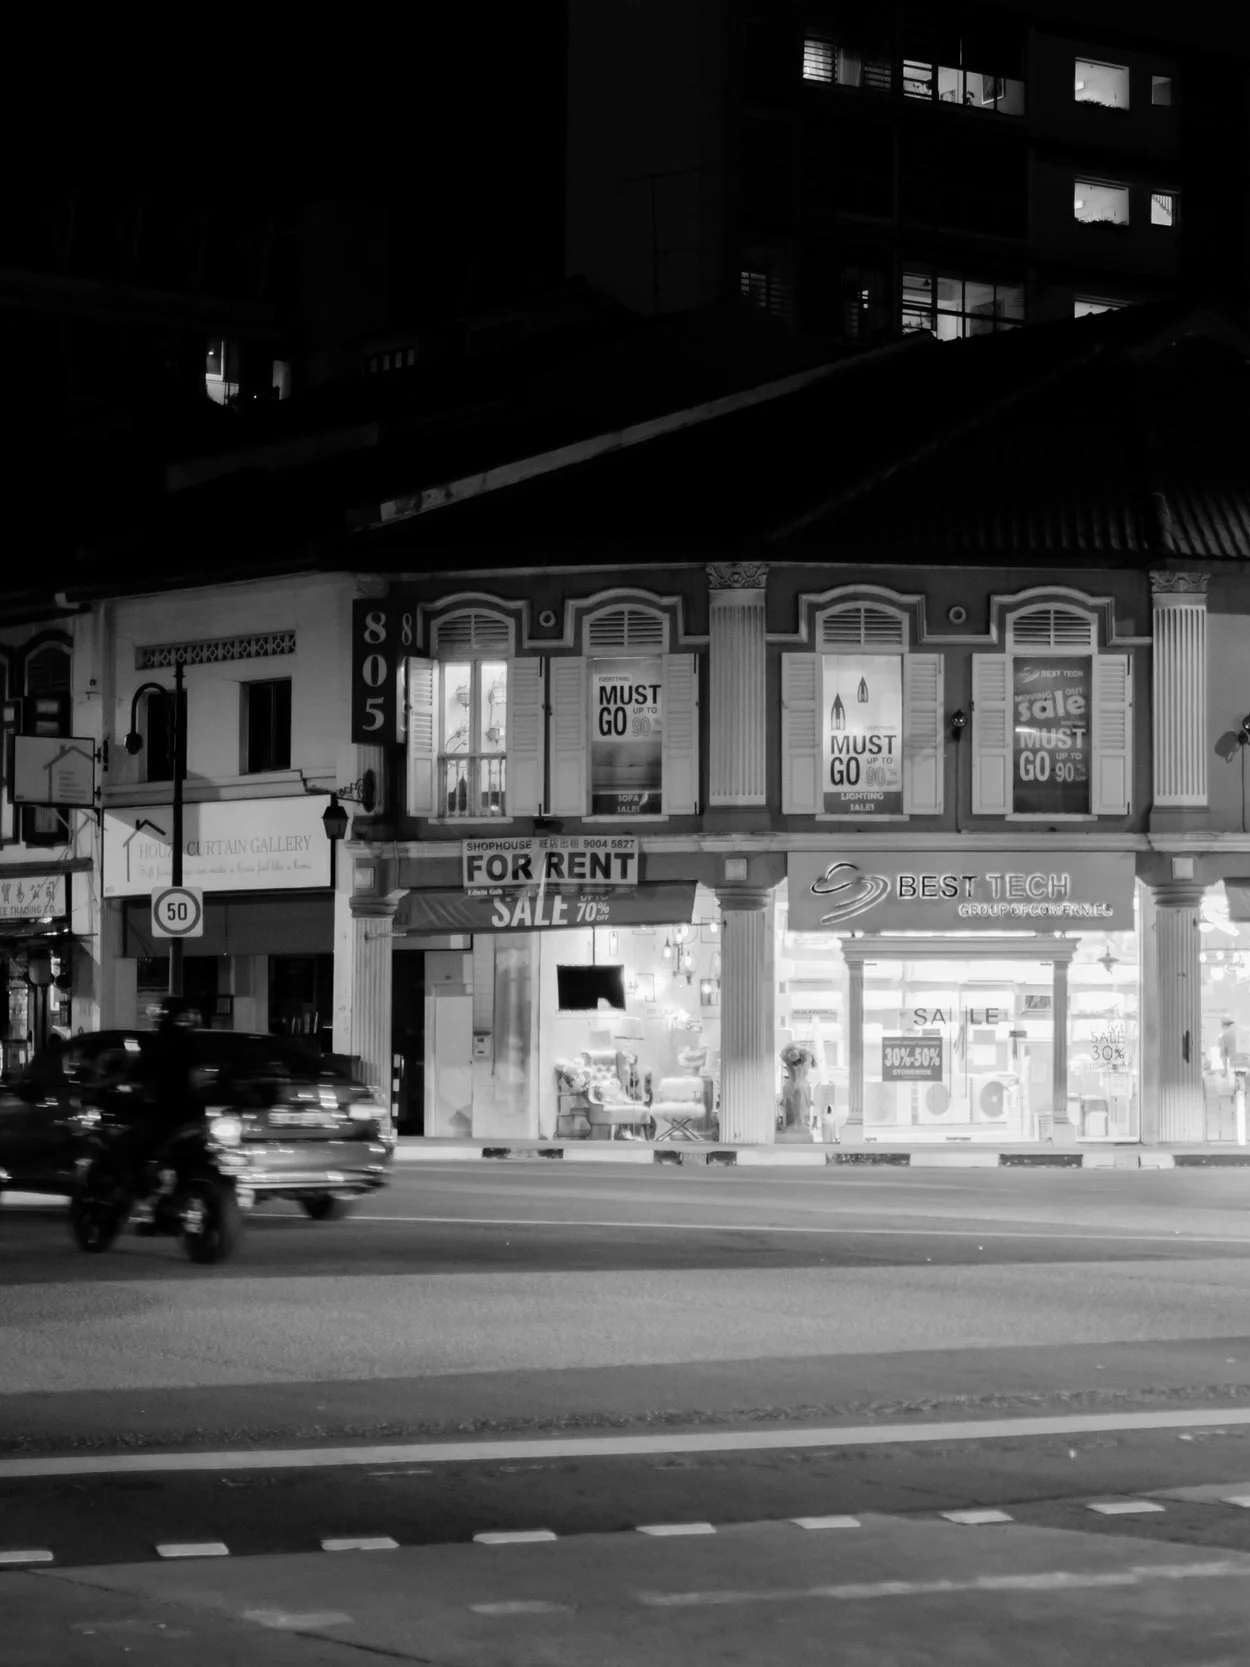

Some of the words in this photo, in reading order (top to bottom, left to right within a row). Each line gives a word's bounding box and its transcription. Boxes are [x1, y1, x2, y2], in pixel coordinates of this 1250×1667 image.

[362, 612, 388, 731] 805
[599, 684, 661, 705] MUST
[1015, 692, 1052, 702] MOVING
[1018, 690, 1085, 721] sale
[599, 706, 627, 736] GO
[831, 735, 897, 755] MUST
[1020, 728, 1086, 749] MUST
[1020, 751, 1050, 781] GO
[1056, 752, 1067, 760] UP
[1071, 752, 1082, 760] TO
[830, 756, 860, 786] GO
[1056, 763, 1074, 782] 90
[841, 792, 884, 800] LIGHTING
[186, 839, 247, 856] CURTAIN
[250, 835, 312, 853] GALLERY
[466, 840, 532, 851] SHOPHOUSE
[583, 839, 607, 848] 9004
[611, 839, 635, 848] 5827
[466, 854, 533, 882] FOR
[544, 851, 635, 880] RENT
[897, 874, 977, 898] BEST
[986, 874, 1070, 899] TECH
[167, 902, 188, 921] 50
[491, 895, 568, 927] SALE
[958, 903, 1009, 918] GROUP
[1090, 1031, 1126, 1044] SALE
[884, 1047, 940, 1067] 30%-50%
[1090, 1045, 1125, 1061] 30%
